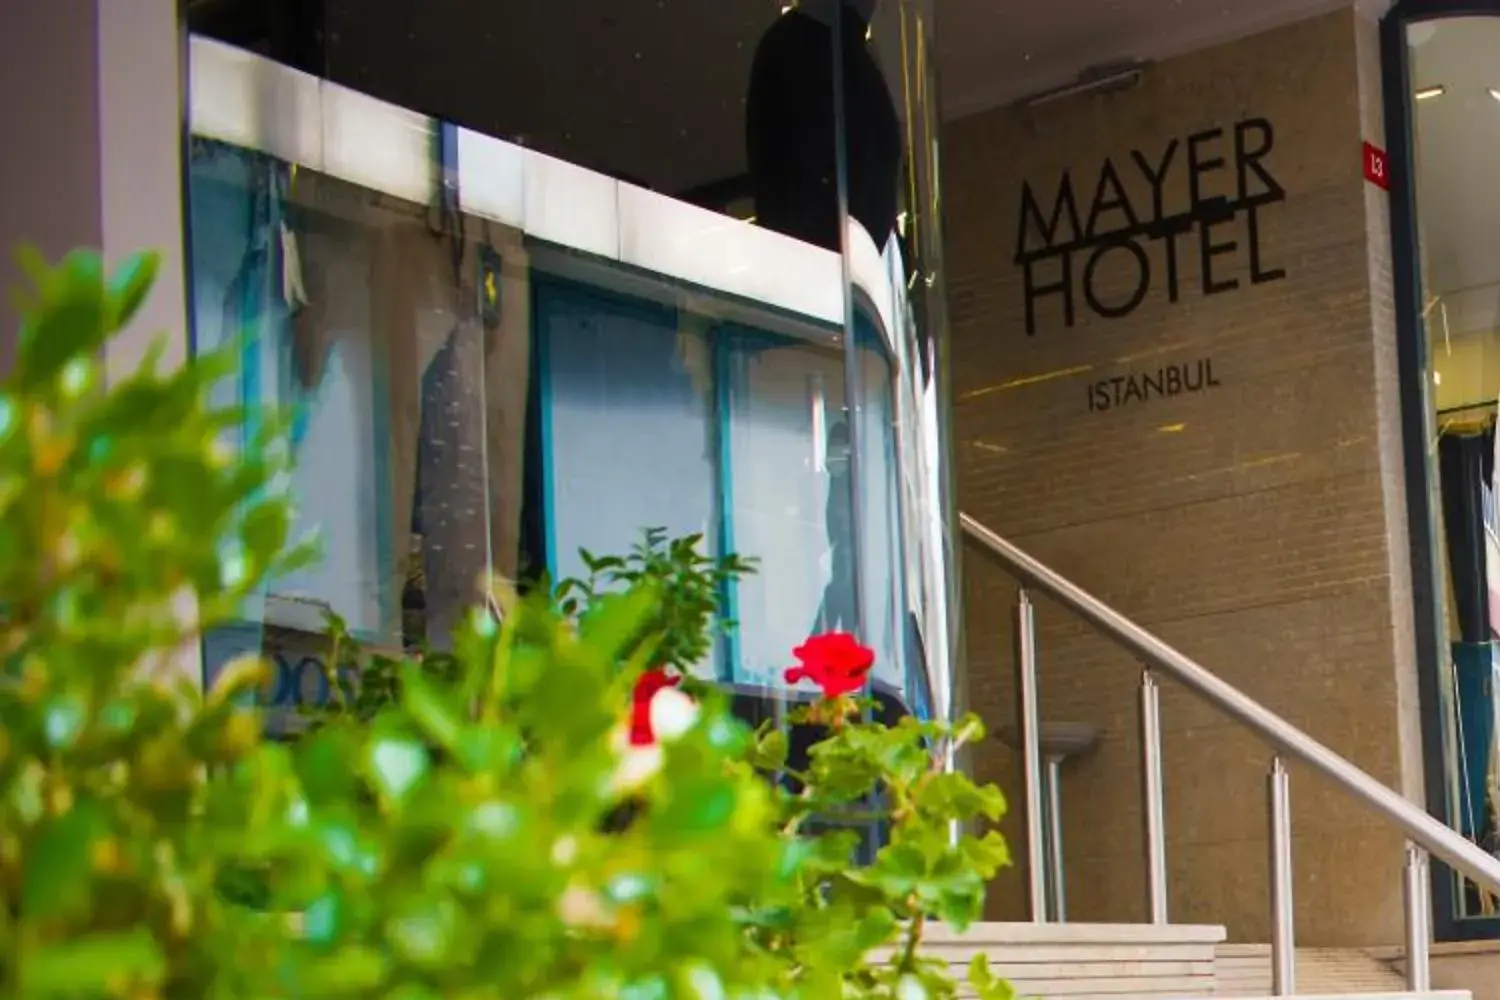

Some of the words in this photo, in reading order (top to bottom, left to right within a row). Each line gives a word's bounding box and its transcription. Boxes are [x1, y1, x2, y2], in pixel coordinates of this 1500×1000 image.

[1014, 116, 1286, 266] MAYER
[1018, 200, 1286, 337] HOTEL
[1087, 357, 1221, 412] ISTANBUL
